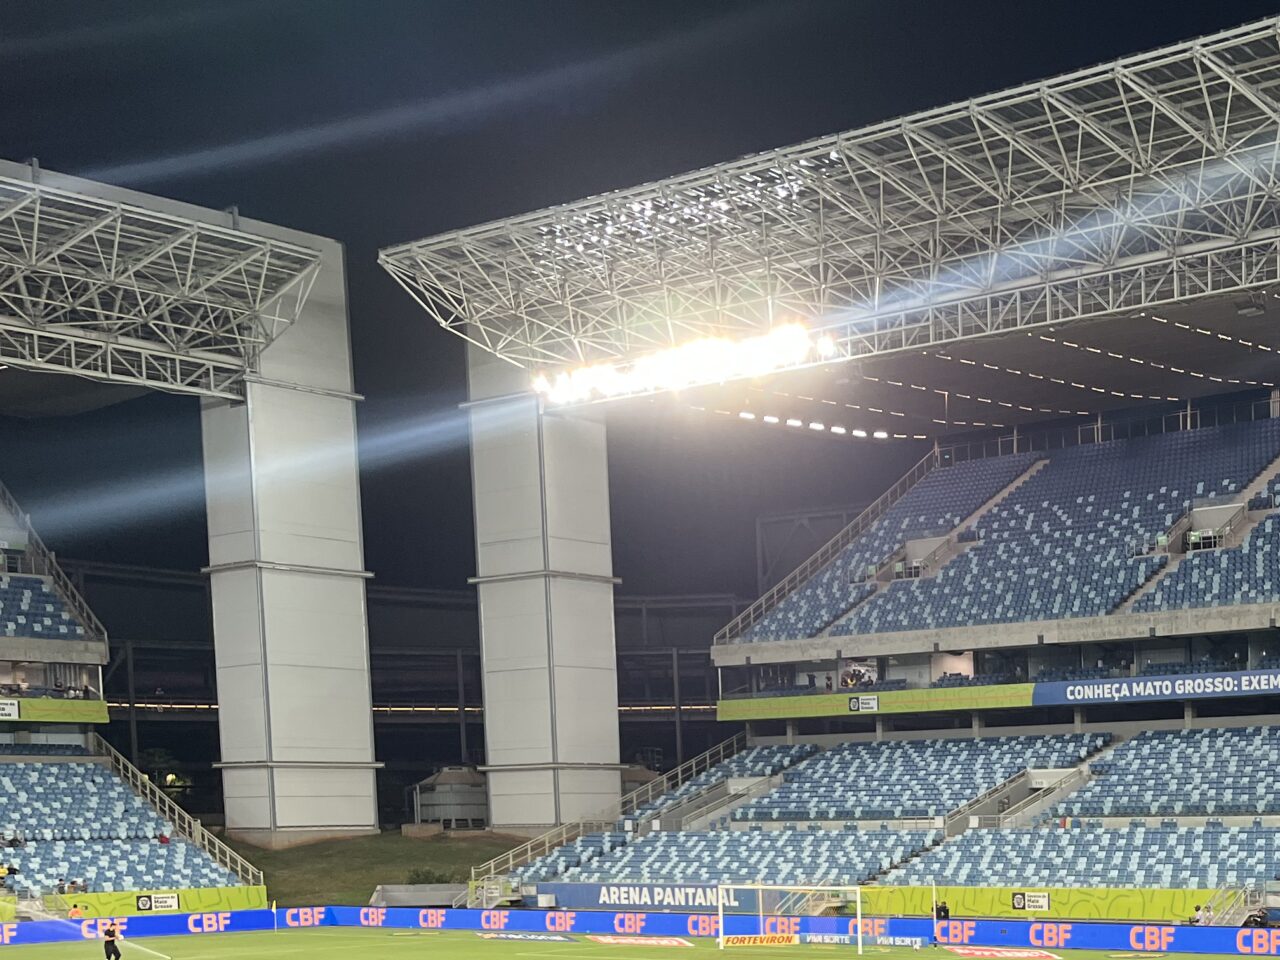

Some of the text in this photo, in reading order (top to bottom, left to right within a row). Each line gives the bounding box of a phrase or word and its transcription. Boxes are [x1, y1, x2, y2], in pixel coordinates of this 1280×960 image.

[1066, 682, 1129, 700] CONHEÇA
[1133, 680, 1171, 696] MATO
[1175, 677, 1238, 694] GROSSO:
[599, 887, 738, 906] ARENA PANTANAL
[188, 912, 231, 932] CBF
[285, 907, 325, 926] CBF
[360, 908, 387, 926] CBF
[419, 909, 446, 928] CBF
[481, 911, 509, 929] CBF
[545, 911, 576, 932] CBF
[614, 913, 646, 934] CBF
[687, 915, 720, 936] CBF
[764, 917, 800, 936] CBF
[725, 936, 793, 945] FORTEVIRON
[936, 921, 976, 944] CBF
[1029, 923, 1072, 947] CBF
[1129, 926, 1175, 950] CBF
